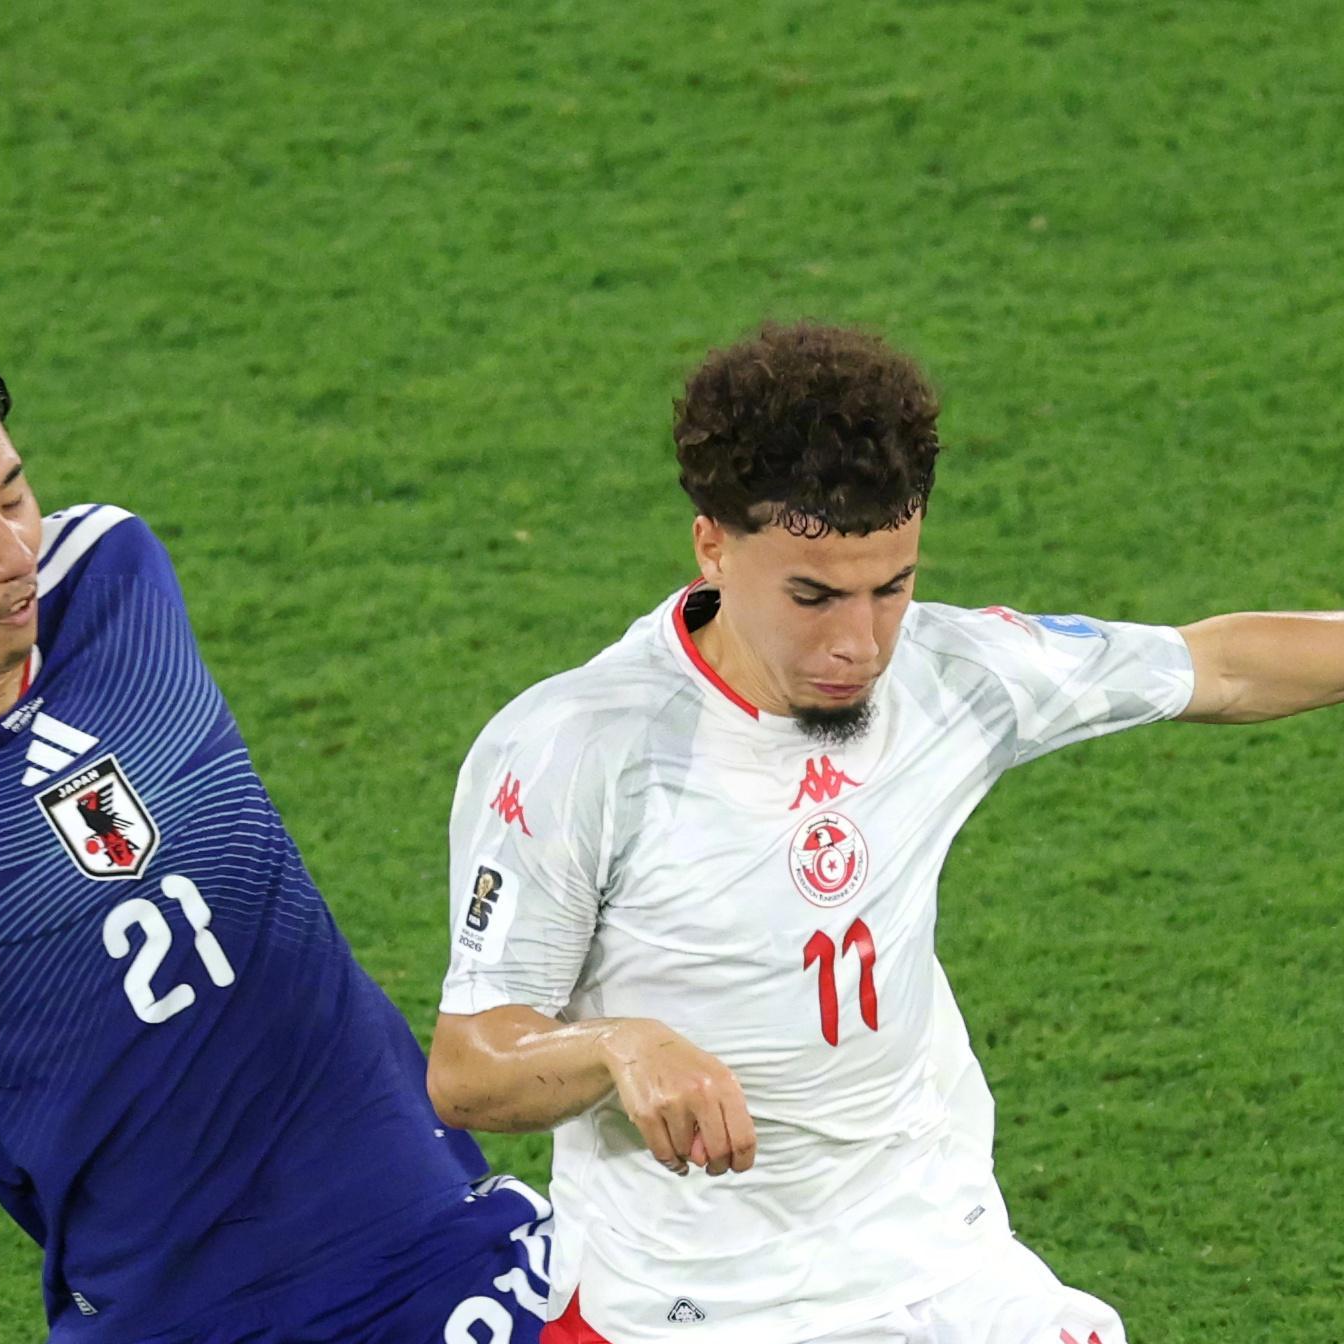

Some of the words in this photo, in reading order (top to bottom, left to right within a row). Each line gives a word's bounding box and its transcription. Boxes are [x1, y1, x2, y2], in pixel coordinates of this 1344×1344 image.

[57, 769, 100, 798] JAPAN
[102, 873, 236, 1024] 21
[458, 934, 483, 952] 2026
[802, 916, 878, 1047] 11
